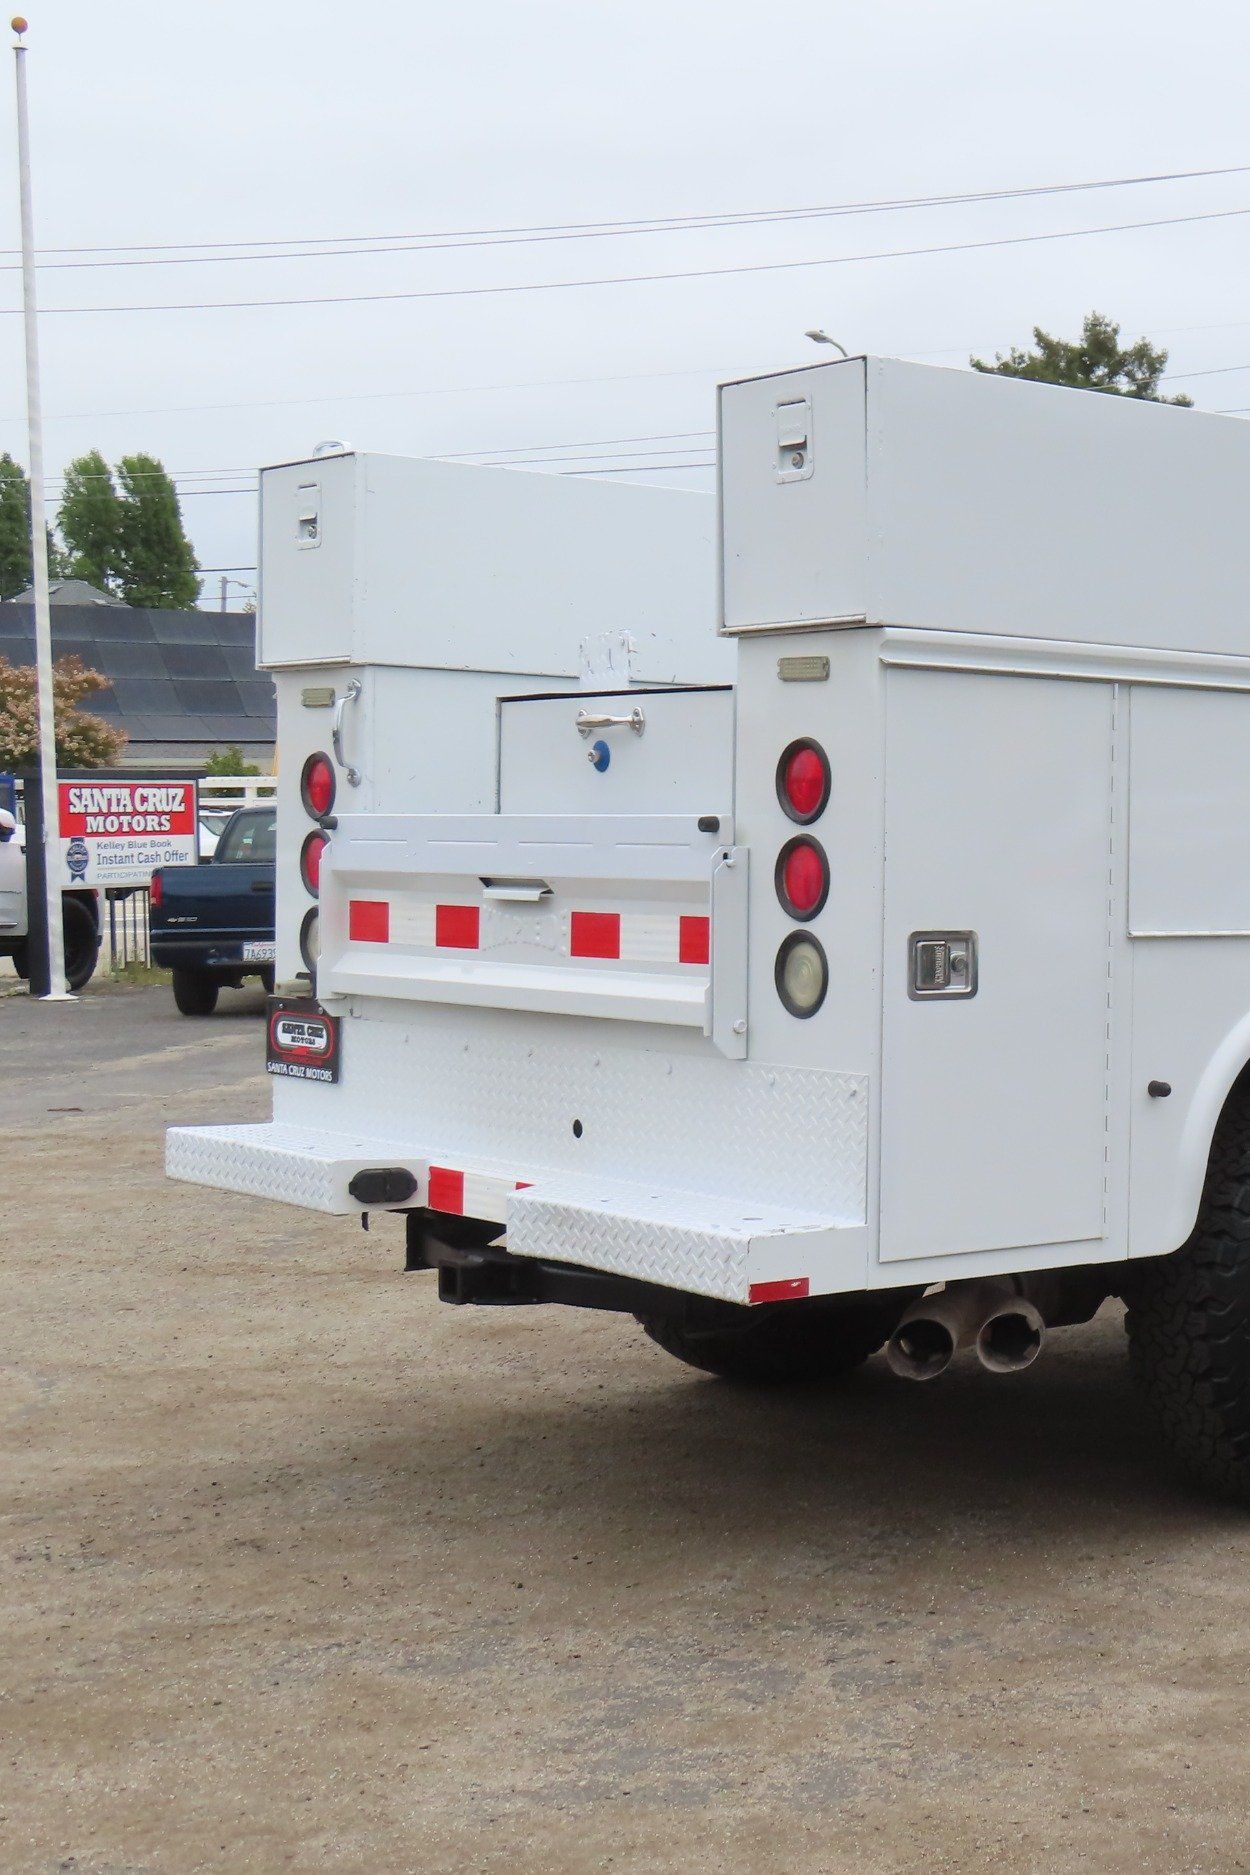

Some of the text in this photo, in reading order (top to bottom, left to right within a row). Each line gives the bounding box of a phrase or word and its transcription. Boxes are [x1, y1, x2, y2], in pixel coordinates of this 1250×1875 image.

[68, 787, 186, 814] SANTA CRUZ
[86, 814, 171, 834] MOTORS
[97, 839, 172, 851] Kelley Blue Book
[97, 852, 134, 865] Instant
[137, 851, 161, 863] Cash
[164, 850, 189, 862] Offer
[97, 870, 153, 880] PARTICIPATIN
[267, 1061, 332, 1081] SANTA CRUZ MOTORS
